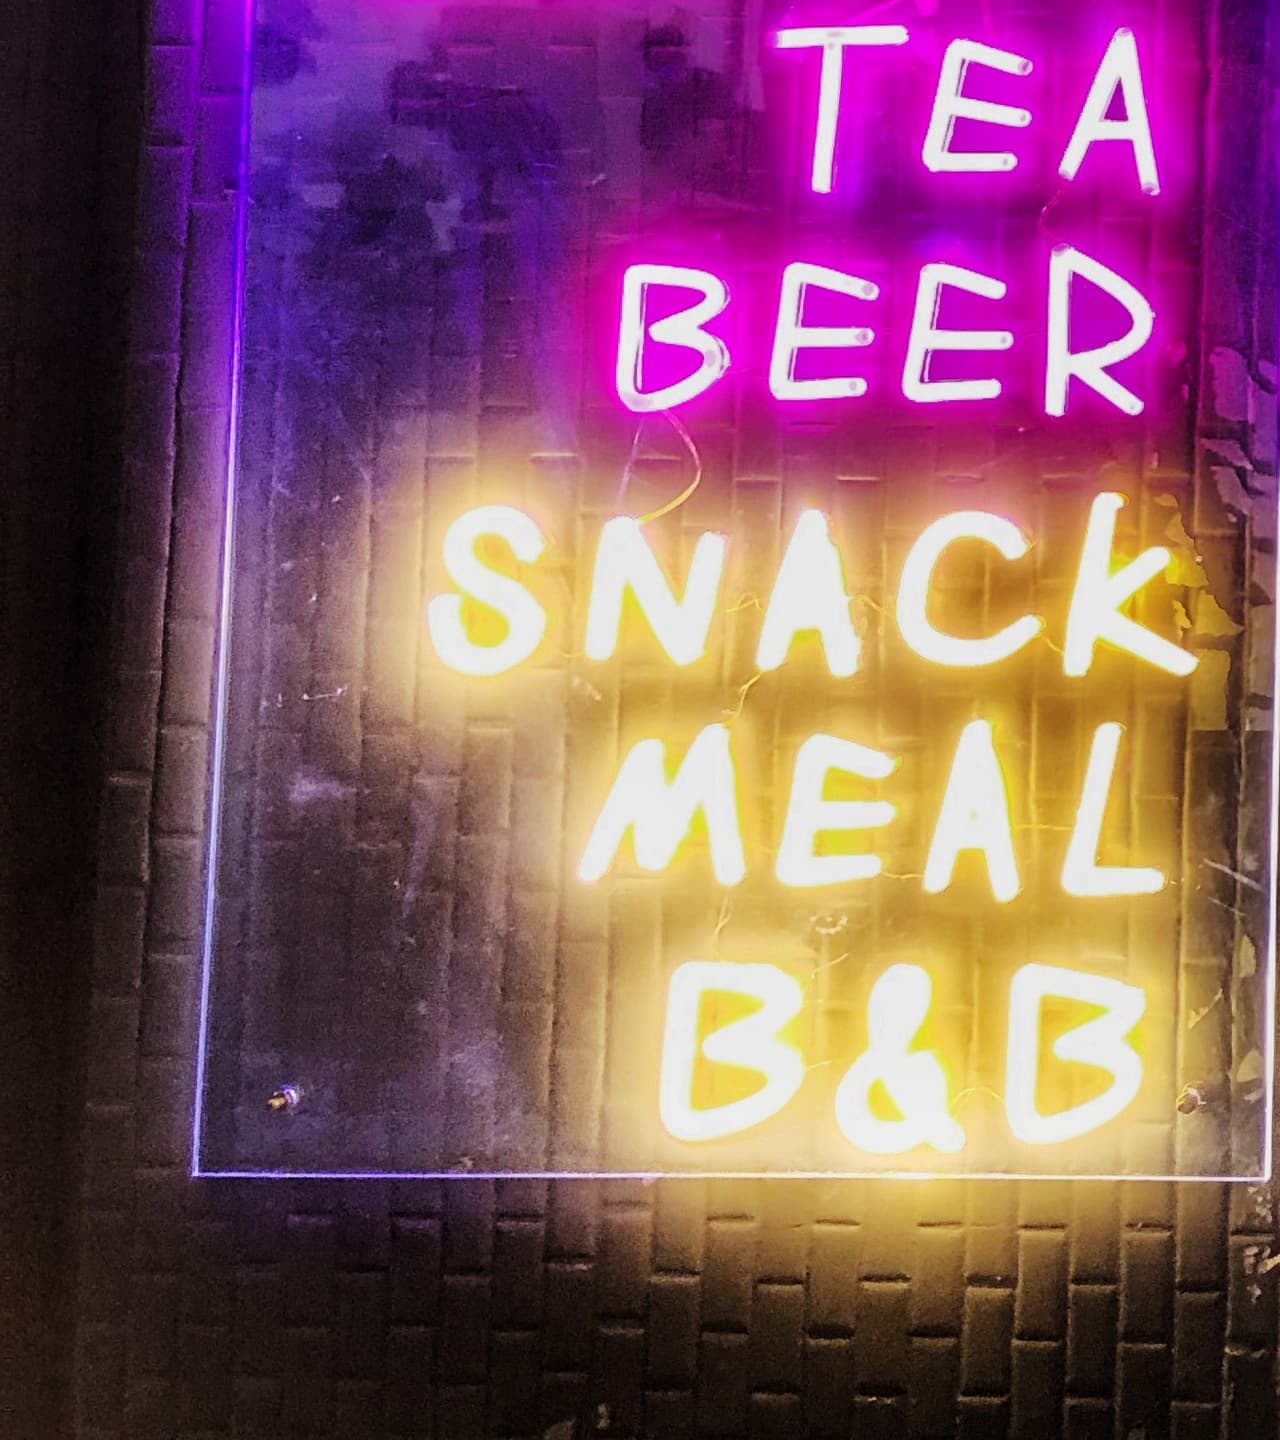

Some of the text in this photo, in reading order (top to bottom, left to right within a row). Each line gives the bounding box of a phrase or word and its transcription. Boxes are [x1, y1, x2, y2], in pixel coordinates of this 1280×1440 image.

[775, 25, 1160, 196] TEA
[615, 243, 1156, 418] BEER
[427, 491, 1199, 677] SNACK
[577, 718, 1167, 903] MEAL
[659, 961, 1147, 1155] B&B
